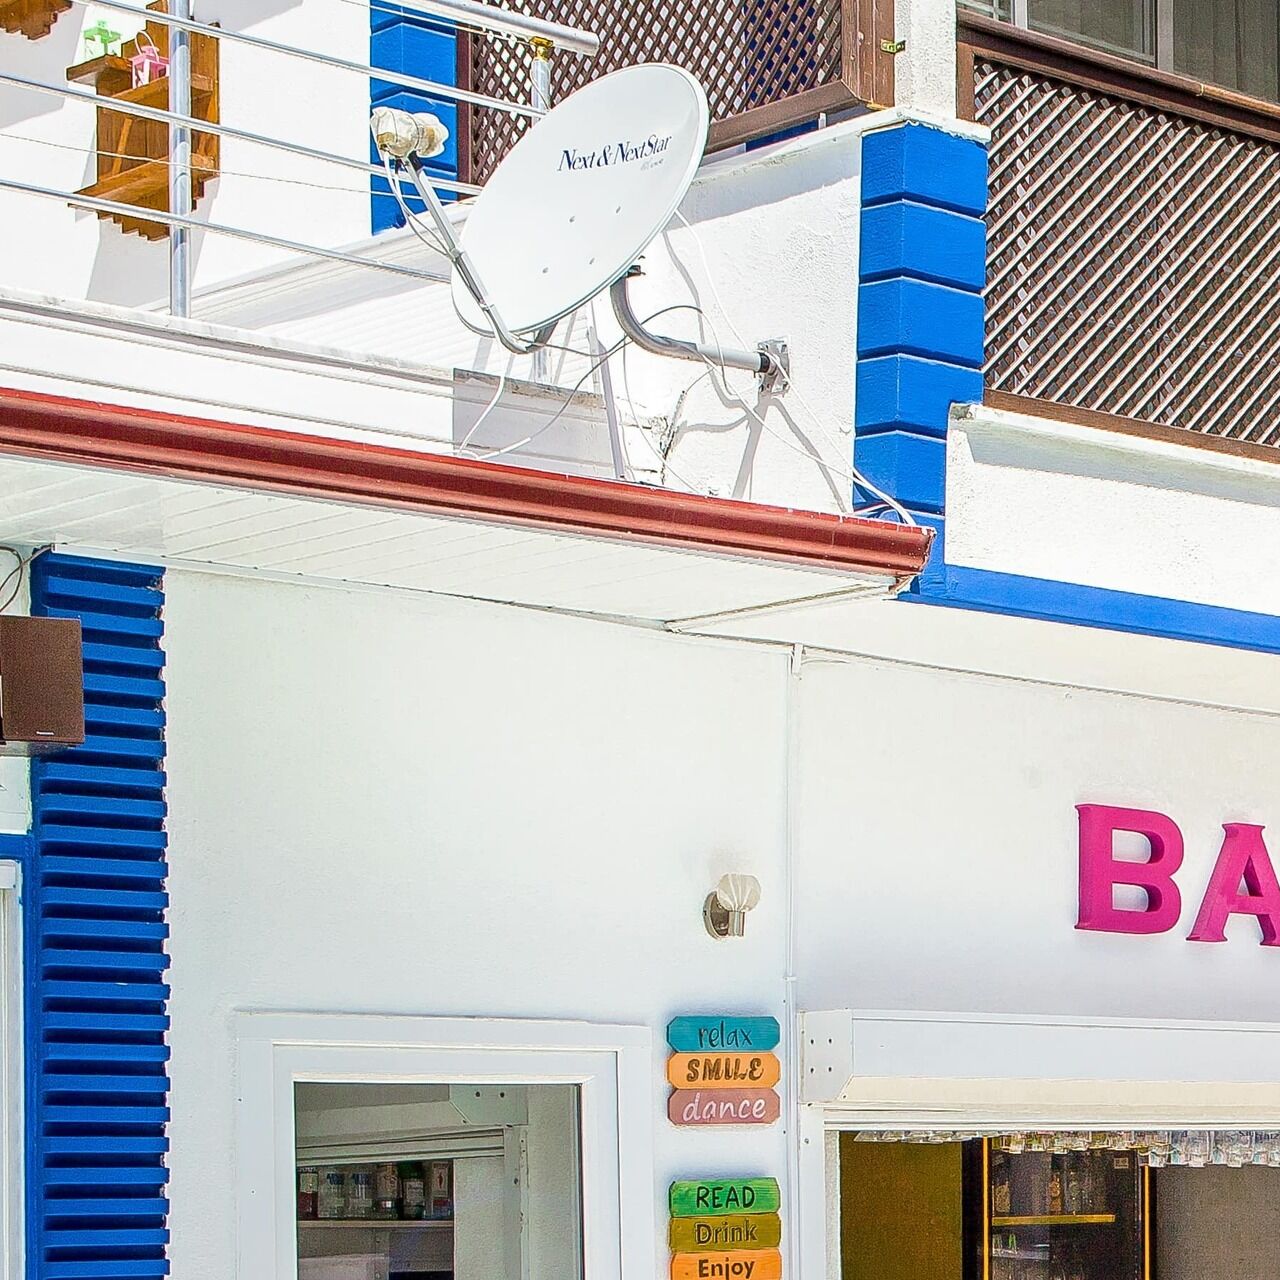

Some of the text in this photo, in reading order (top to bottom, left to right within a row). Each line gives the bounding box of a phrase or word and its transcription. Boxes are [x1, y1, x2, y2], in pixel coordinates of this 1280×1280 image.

[557, 149, 596, 171] Next
[596, 144, 612, 168] &
[698, 1020, 753, 1049] relax
[686, 1057, 765, 1082] SMILE
[682, 1092, 766, 1122] dance
[696, 1185, 756, 1210] READ
[694, 1219, 758, 1246] Drink
[697, 1257, 756, 1280] Enjoy
